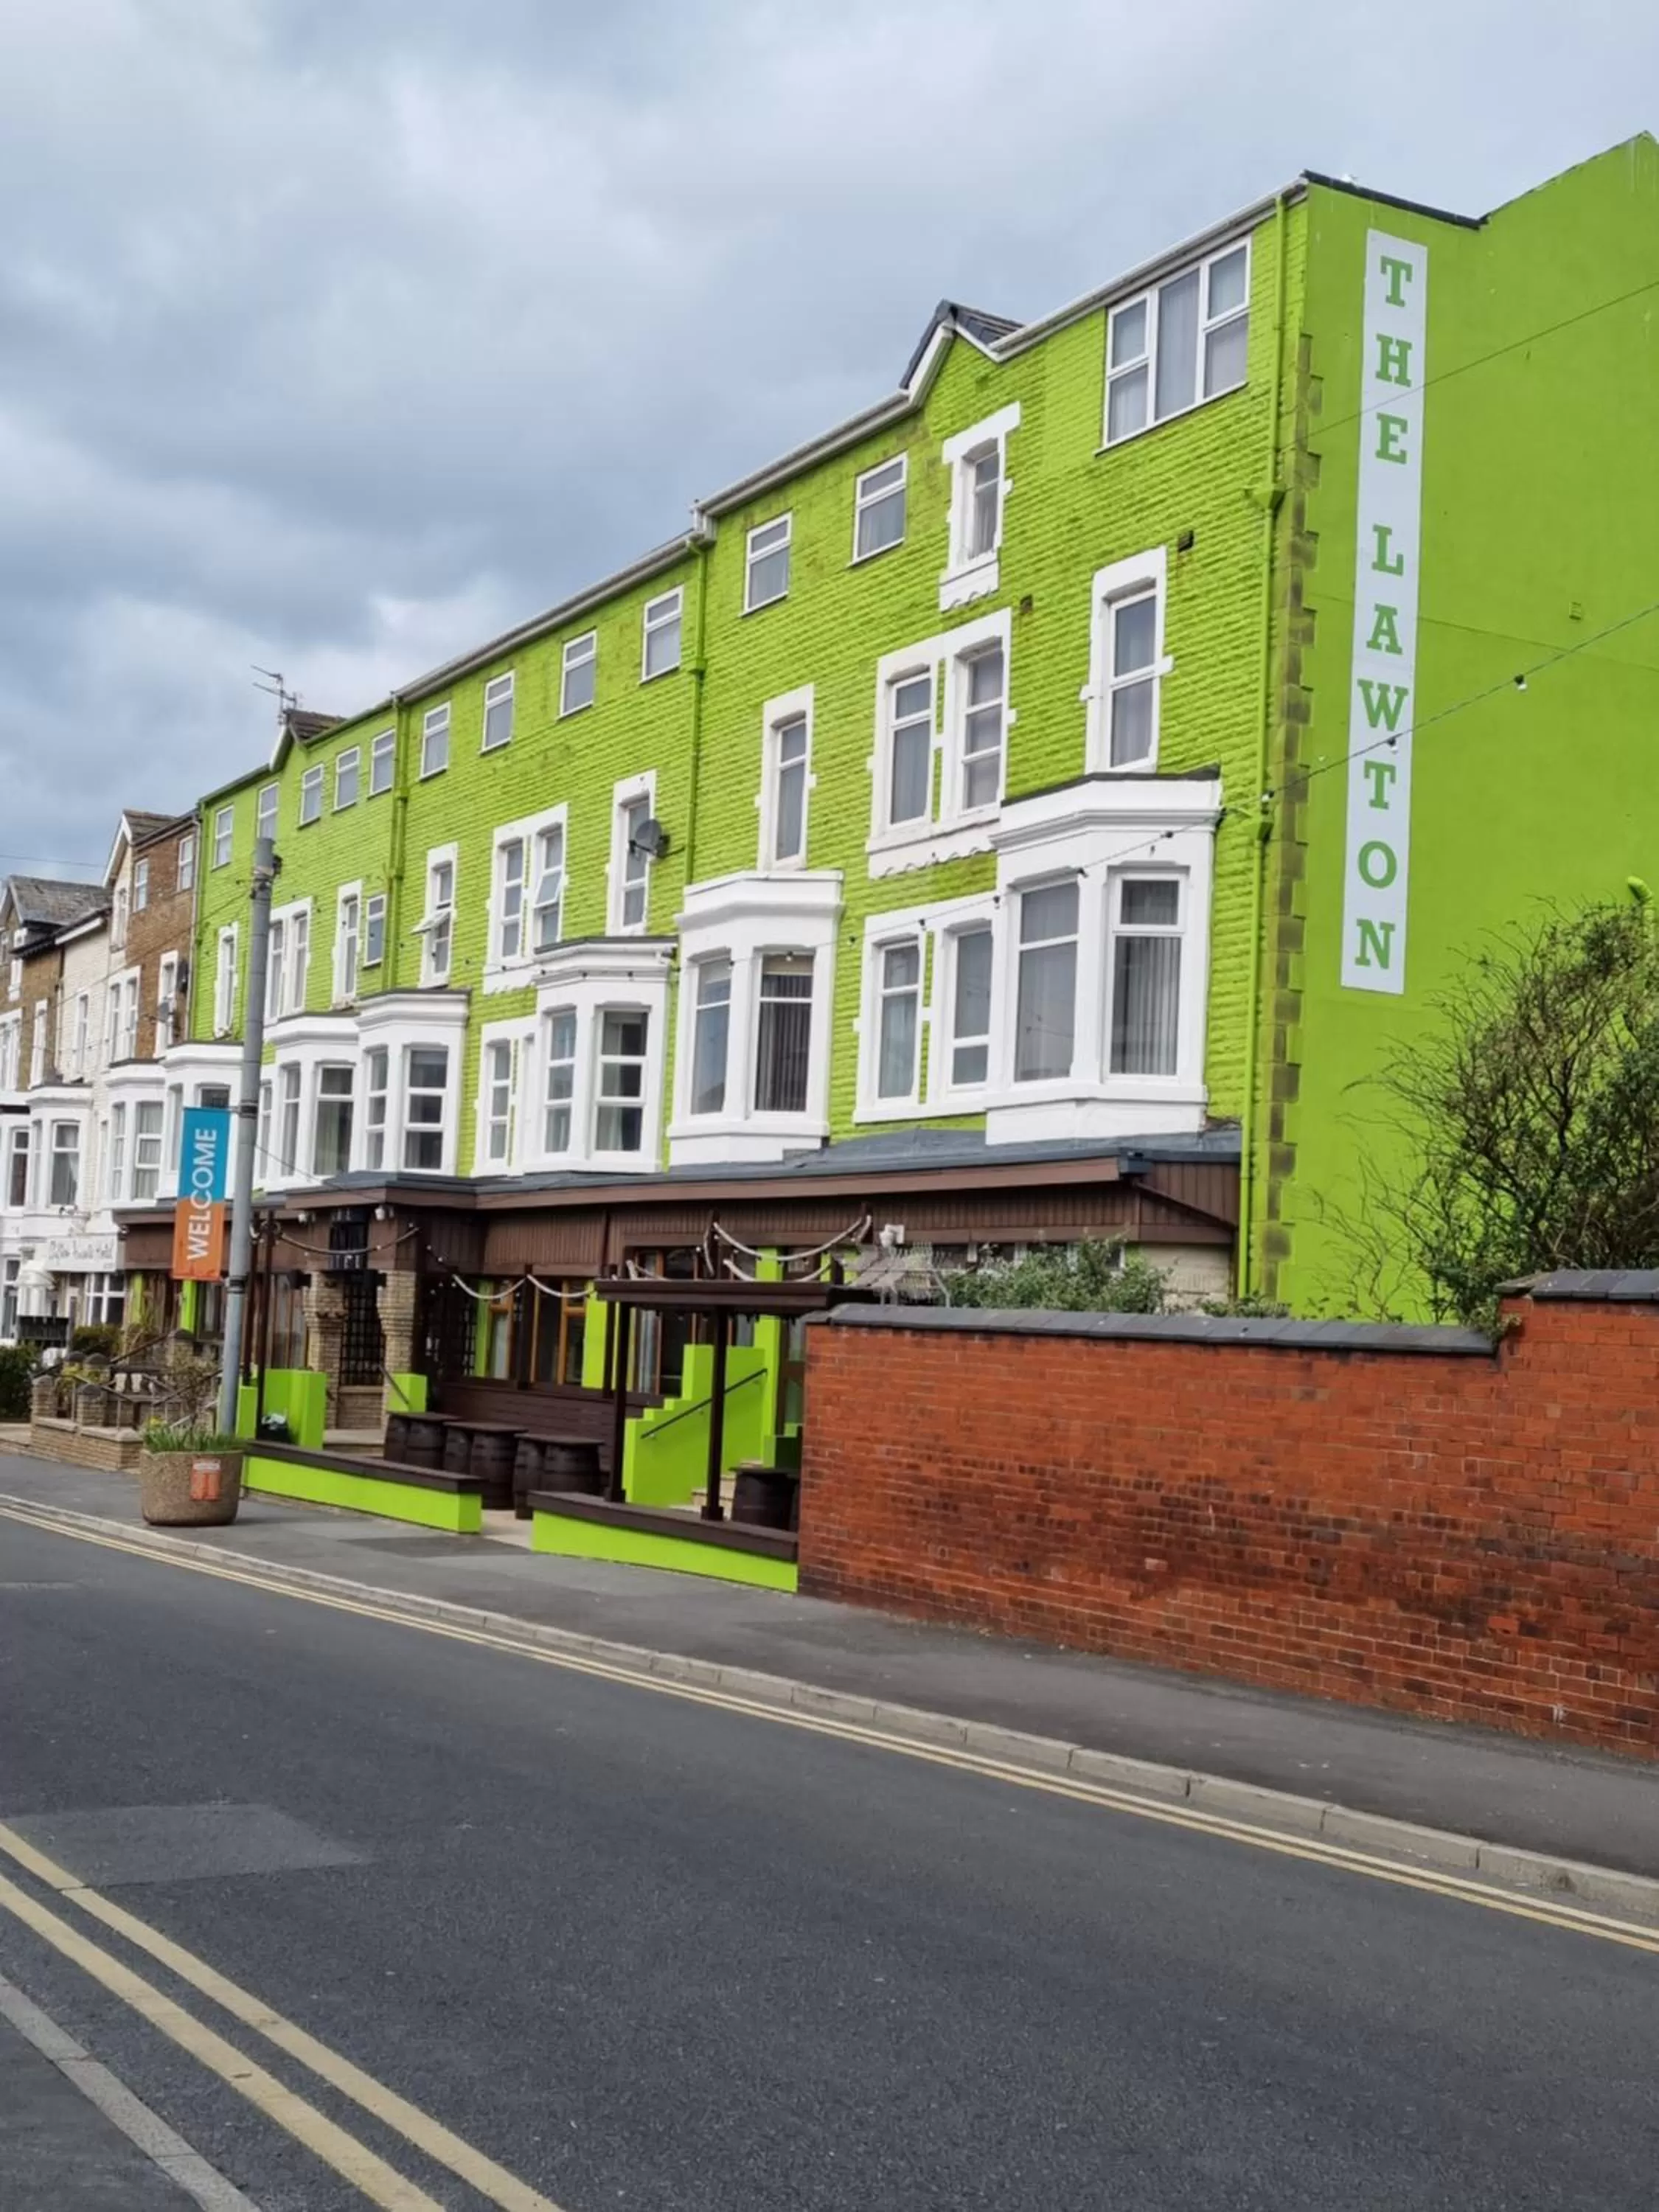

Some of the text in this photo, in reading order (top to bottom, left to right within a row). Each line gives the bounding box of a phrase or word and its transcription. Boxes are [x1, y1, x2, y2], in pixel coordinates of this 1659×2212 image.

[1354, 254, 1413, 970] THE LAWTON
[187, 1128, 217, 1260] WELCOME
